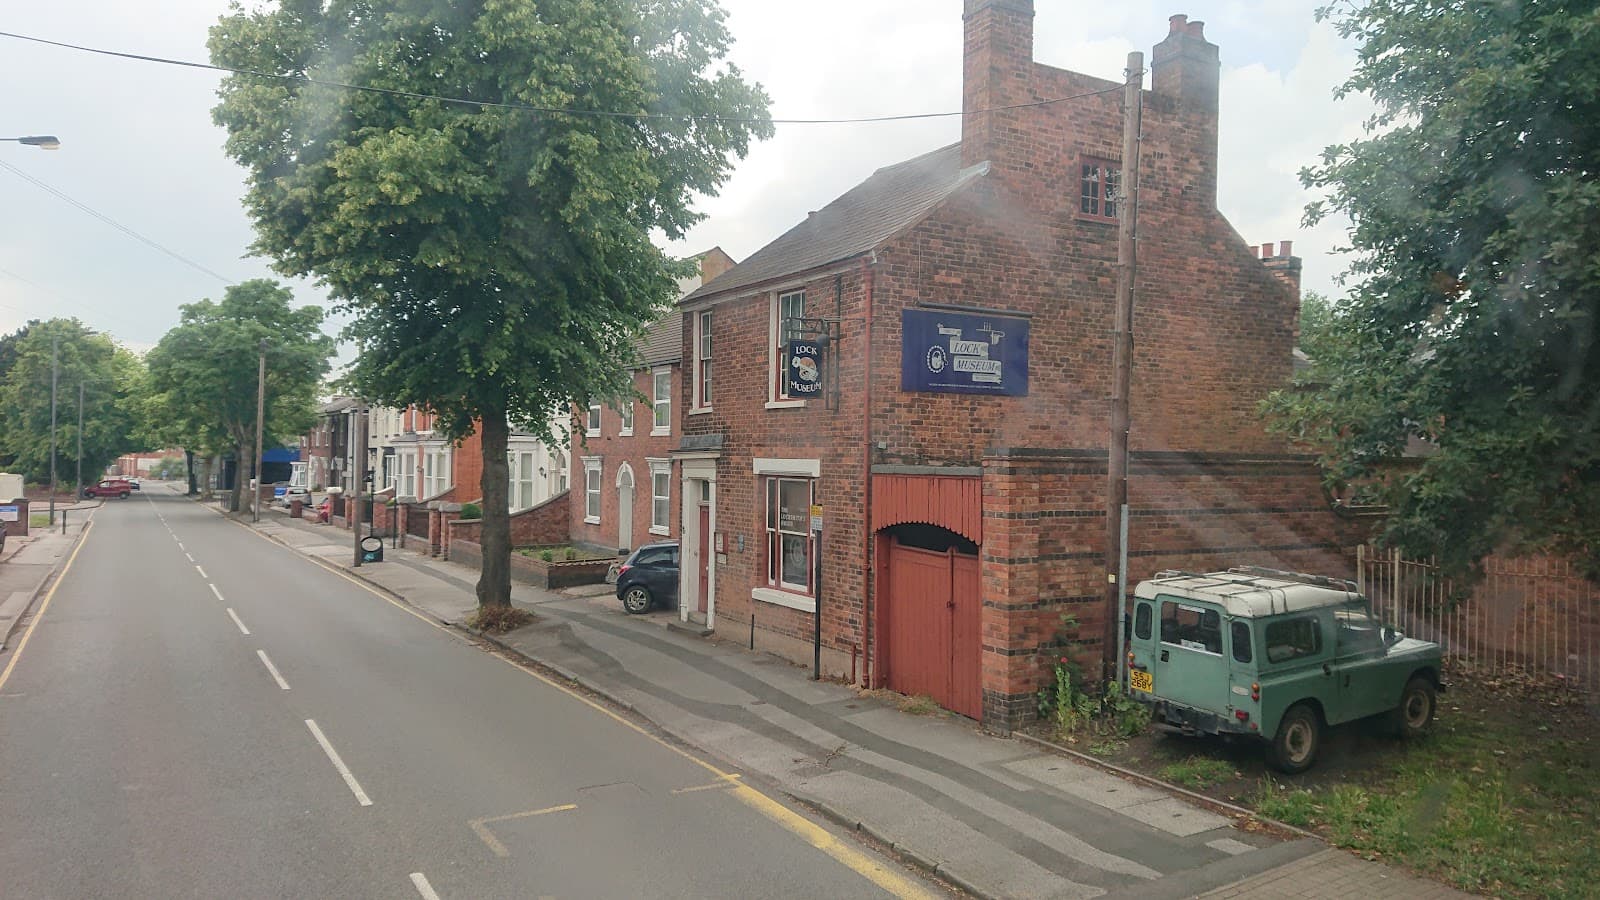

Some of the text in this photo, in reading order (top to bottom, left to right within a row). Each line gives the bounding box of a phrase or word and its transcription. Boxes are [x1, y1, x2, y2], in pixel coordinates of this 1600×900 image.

[796, 345, 817, 355] LOCK
[954, 342, 981, 353] LOCK
[957, 360, 996, 372] MUSEUM
[790, 380, 822, 393] MUSEUM
[1132, 679, 1152, 690] 268Y
